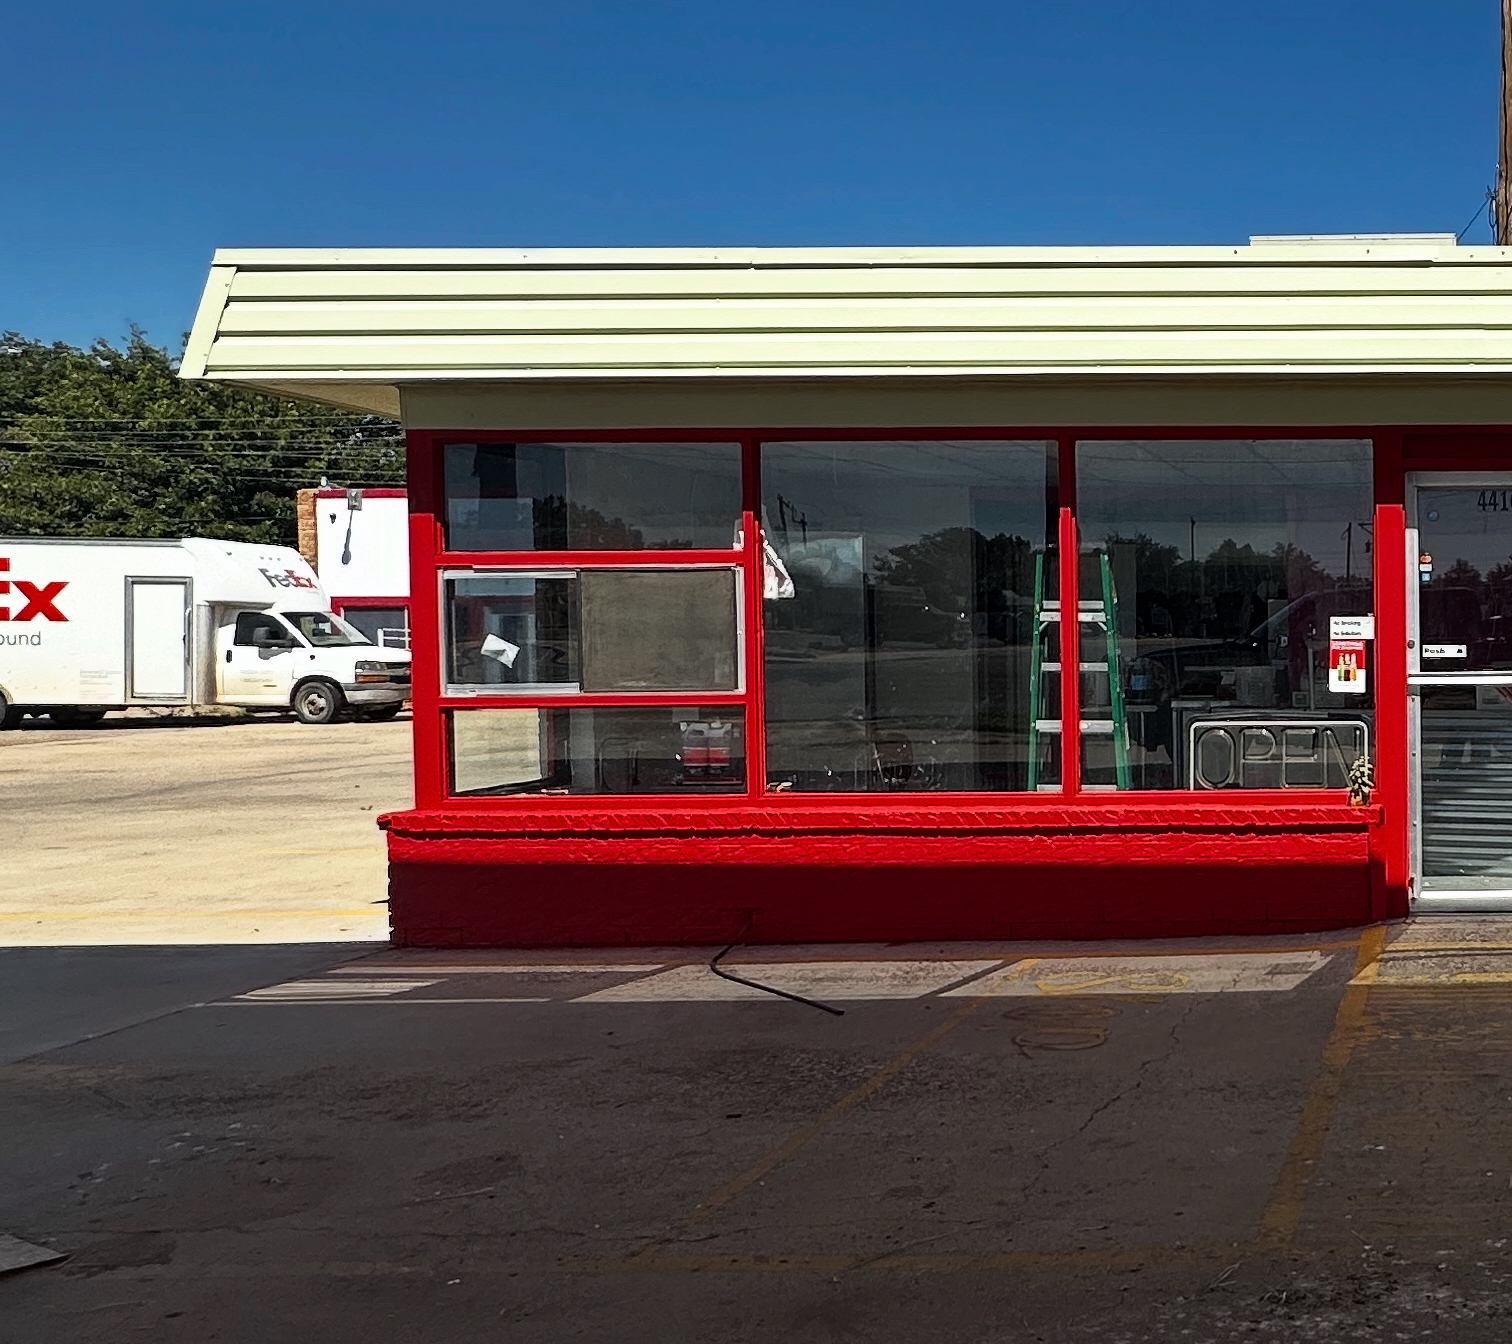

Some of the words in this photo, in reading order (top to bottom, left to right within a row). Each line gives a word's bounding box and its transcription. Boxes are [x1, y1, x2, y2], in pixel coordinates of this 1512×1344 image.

[0, 558, 70, 622] x
[257, 568, 318, 588] FedEx
[1196, 726, 1362, 790] OPEN
